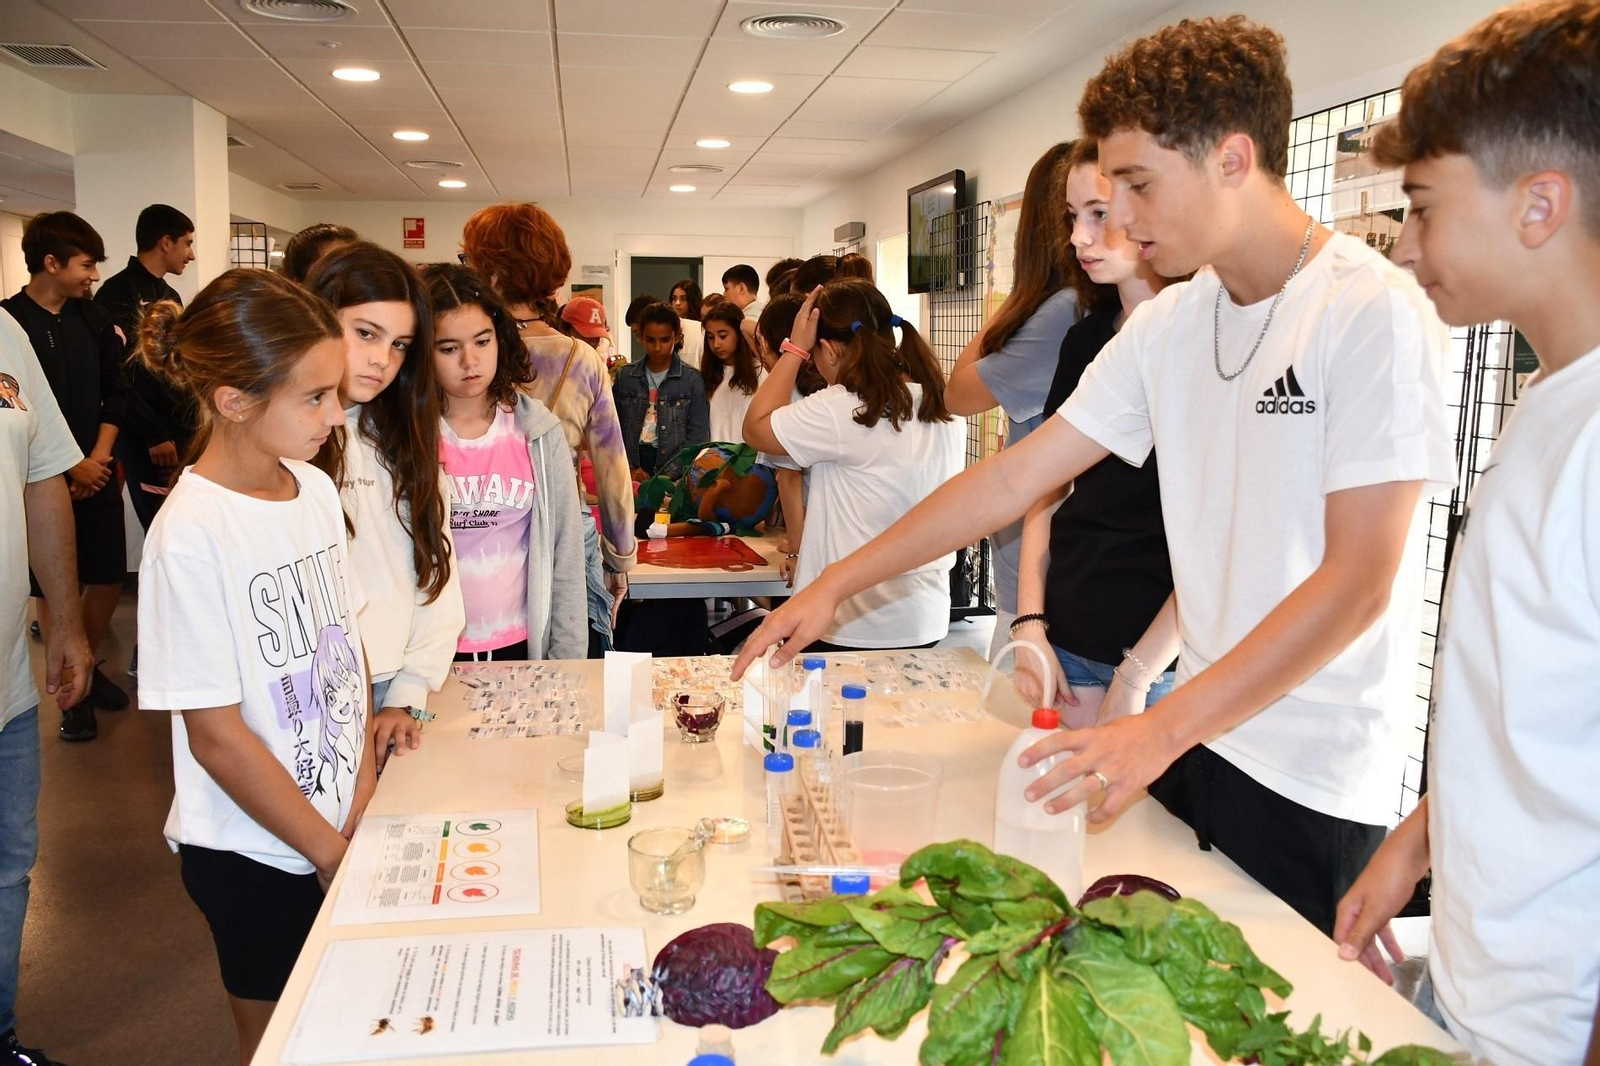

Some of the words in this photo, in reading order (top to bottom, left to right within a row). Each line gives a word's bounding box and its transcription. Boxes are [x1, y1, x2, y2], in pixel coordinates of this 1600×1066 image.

[589, 308, 602, 324] A
[1255, 396, 1316, 414] adidas
[447, 473, 534, 509] AWAII
[450, 518, 467, 530] Surf
[468, 520, 489, 528] Club
